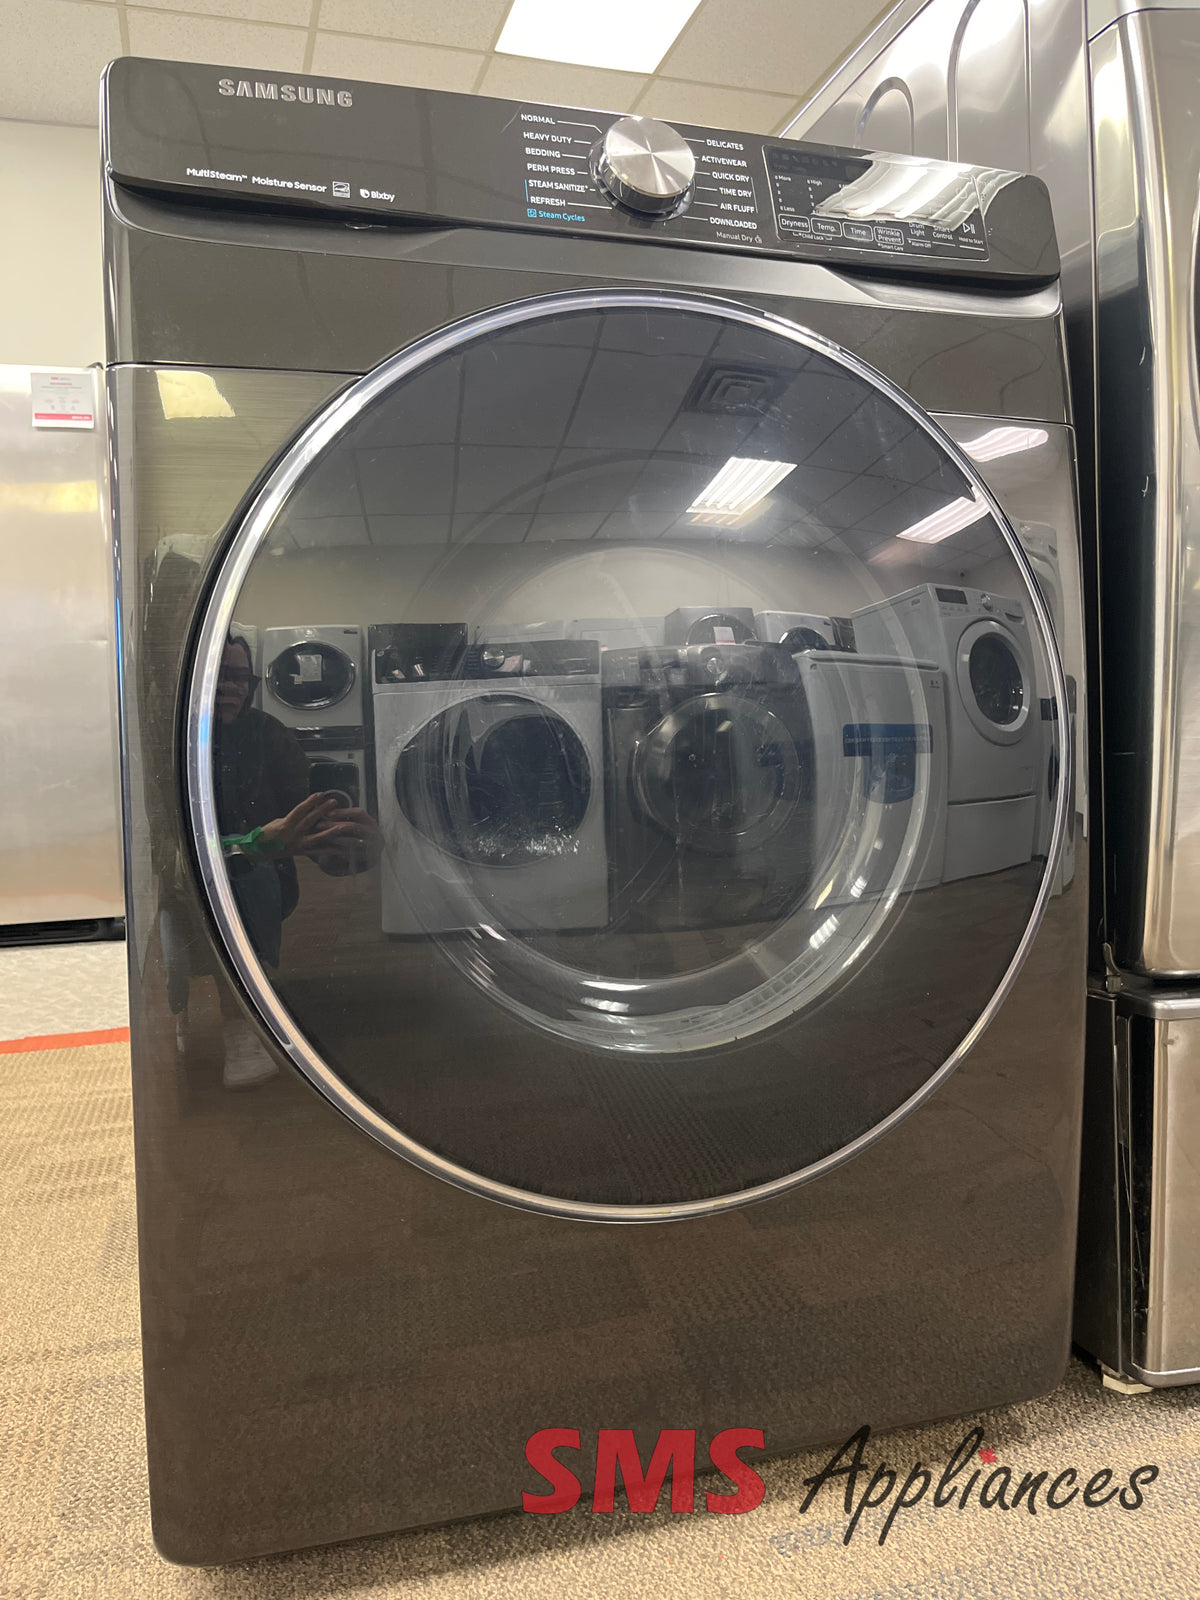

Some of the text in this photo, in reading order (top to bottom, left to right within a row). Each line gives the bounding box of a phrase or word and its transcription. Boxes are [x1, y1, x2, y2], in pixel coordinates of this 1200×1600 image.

[218, 78, 353, 107] SAMSUNG
[520, 113, 555, 125] NORMAL
[523, 131, 572, 144] HEAVY DUTY
[706, 139, 744, 151] DELICATES
[525, 147, 561, 158] BEDDING
[701, 155, 747, 168] ACTIVEWEAR
[526, 163, 576, 176] PERM PRESS
[712, 171, 749, 183] QUICK DRY
[251, 175, 293, 190] Moisture
[294, 181, 328, 193] Sensor
[528, 179, 554, 189] STEAM
[371, 190, 396, 203] Bixby
[719, 187, 752, 198] TIME DRY
[530, 196, 566, 207] REFRESH
[720, 202, 755, 213] AIR FLUFF
[783, 205, 796, 213] Less
[538, 210, 586, 223] Steam Cycles
[709, 216, 757, 230] DOWNLOADED
[781, 218, 809, 229] Dryness
[801, 232, 813, 240] Child
[850, 226, 867, 236] Time
[876, 227, 901, 238] Wrinkle
[910, 229, 926, 237] Light
[932, 231, 954, 241] Control
[716, 231, 753, 243] Manual Dry
[878, 234, 902, 244] Prevent
